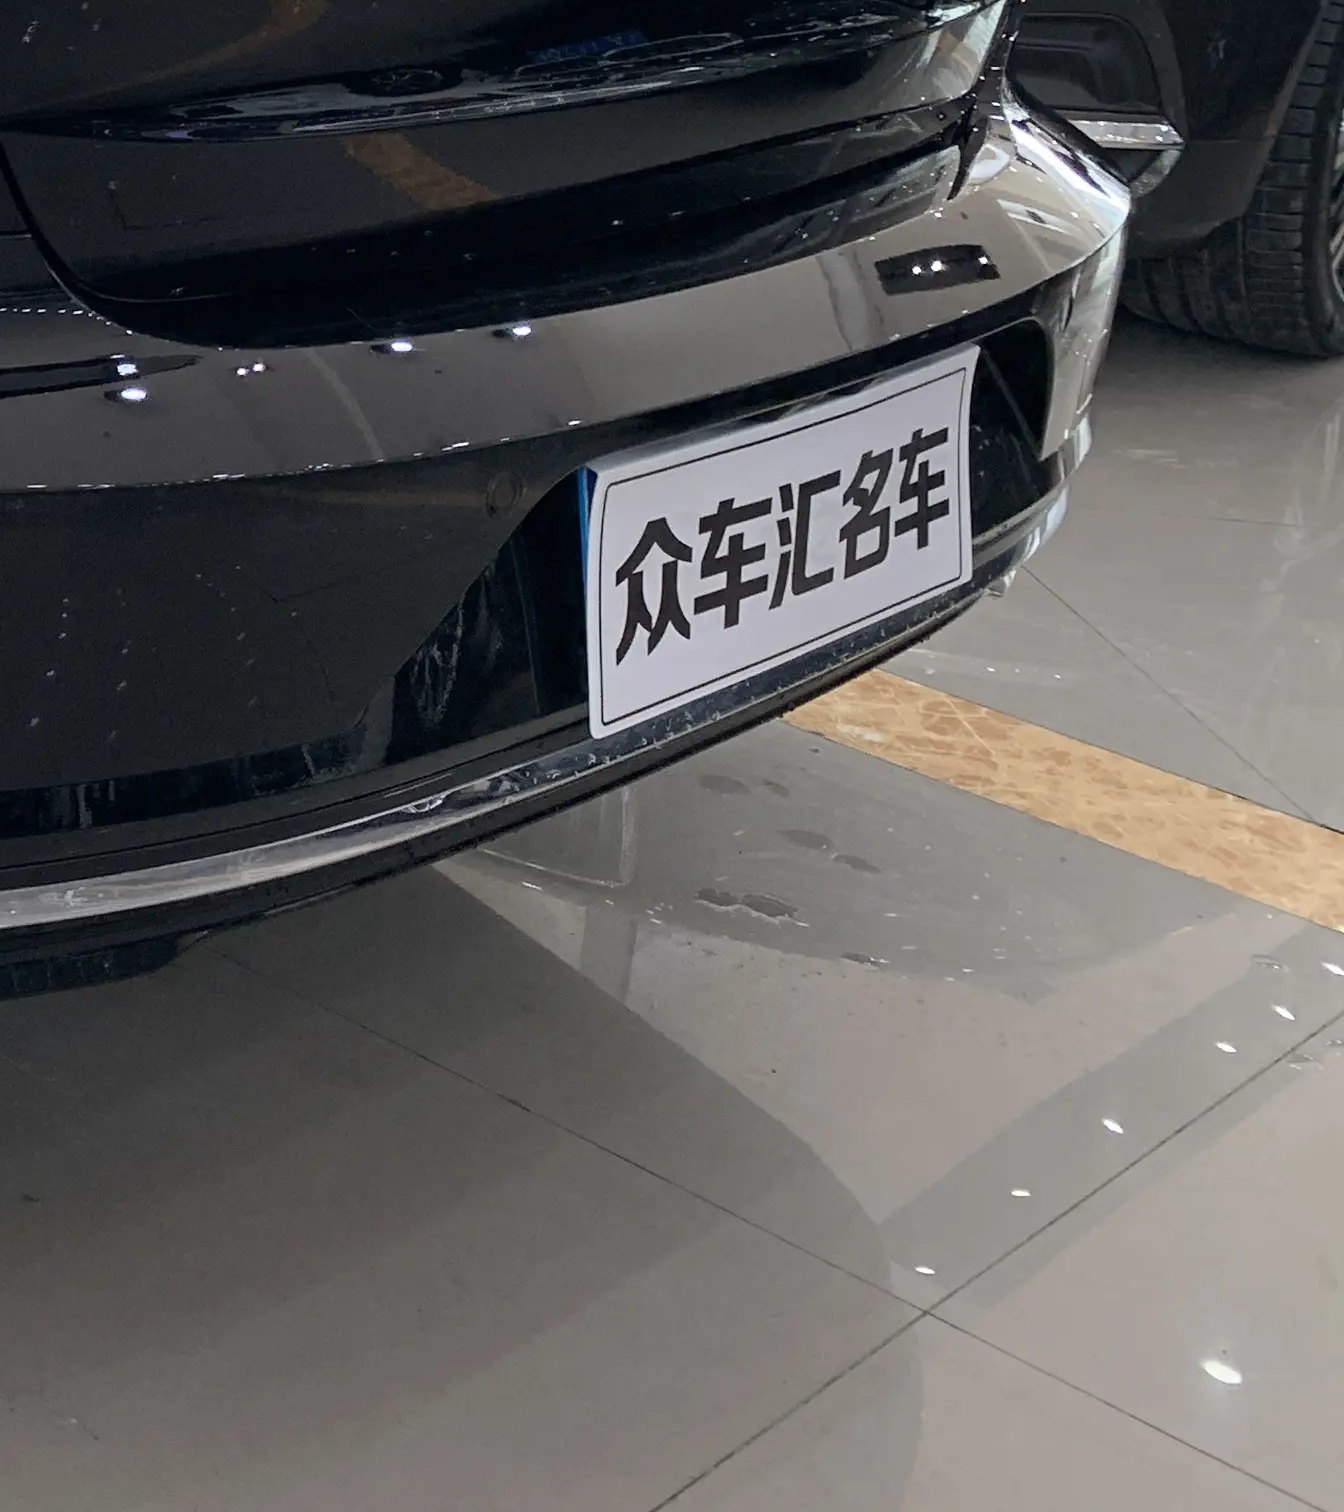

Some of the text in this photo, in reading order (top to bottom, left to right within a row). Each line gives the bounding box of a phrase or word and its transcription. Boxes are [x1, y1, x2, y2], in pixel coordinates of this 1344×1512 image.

[615, 426, 950, 666] 众车汇名车
